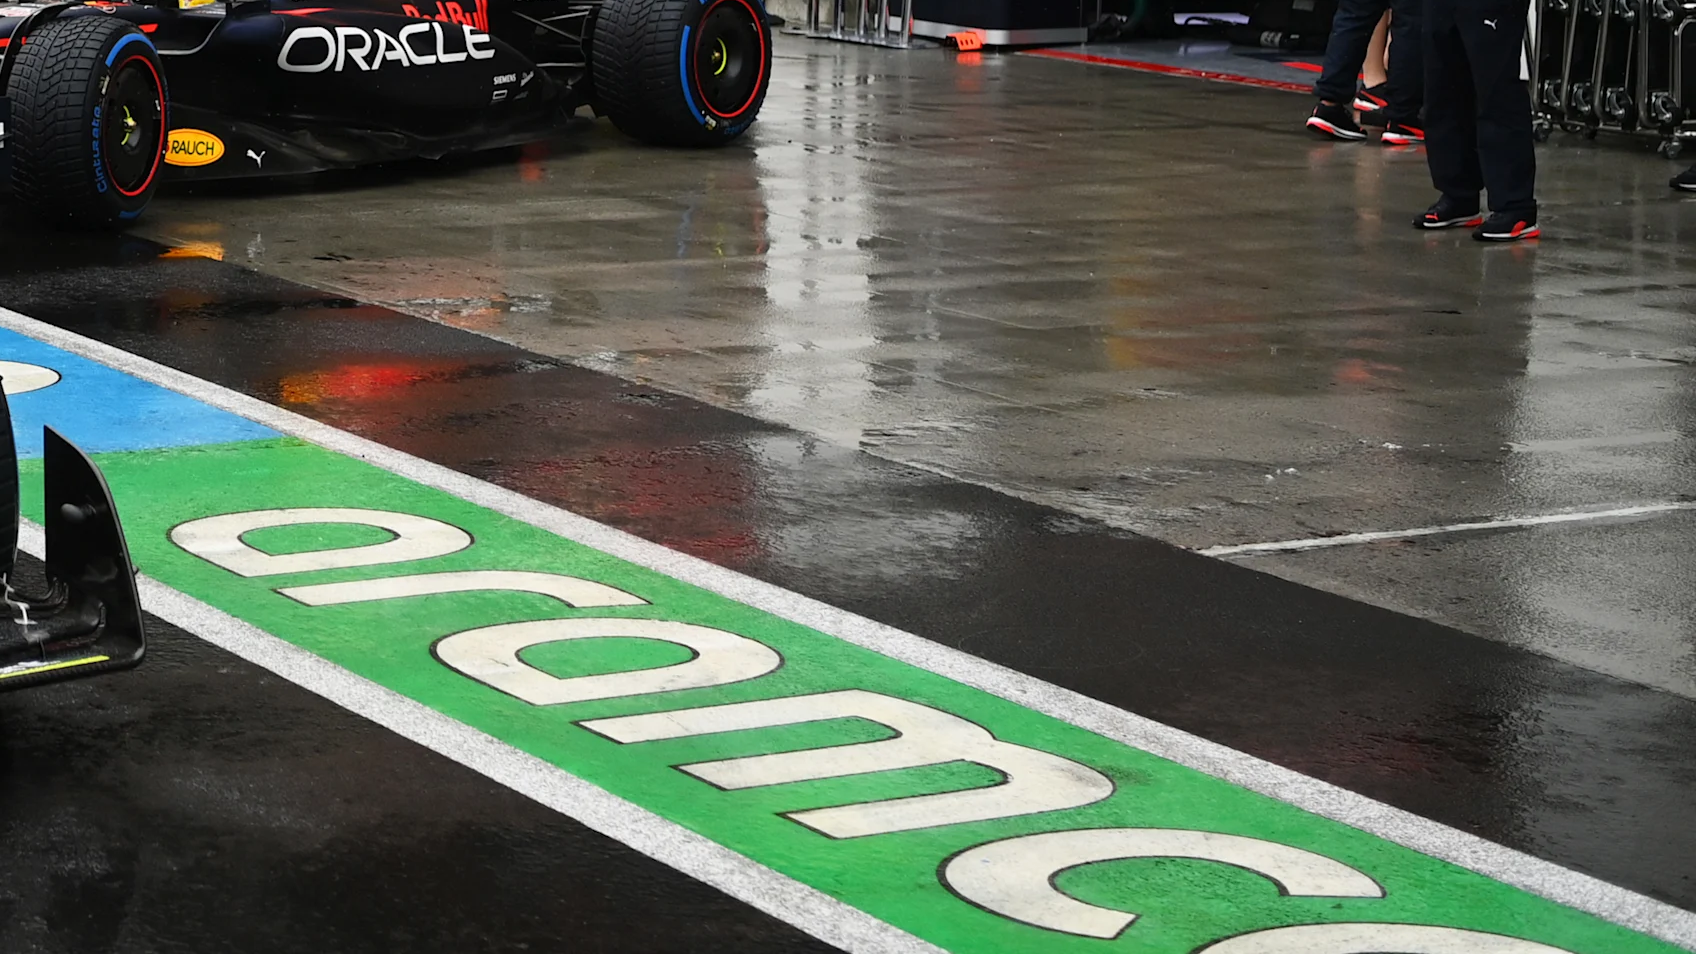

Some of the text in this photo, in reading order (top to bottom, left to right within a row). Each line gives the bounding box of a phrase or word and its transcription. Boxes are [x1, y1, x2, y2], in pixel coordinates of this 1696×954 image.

[278, 22, 496, 73] ORACLE
[170, 140, 215, 156] RAUCH
[168, 507, 1584, 954] aramc
